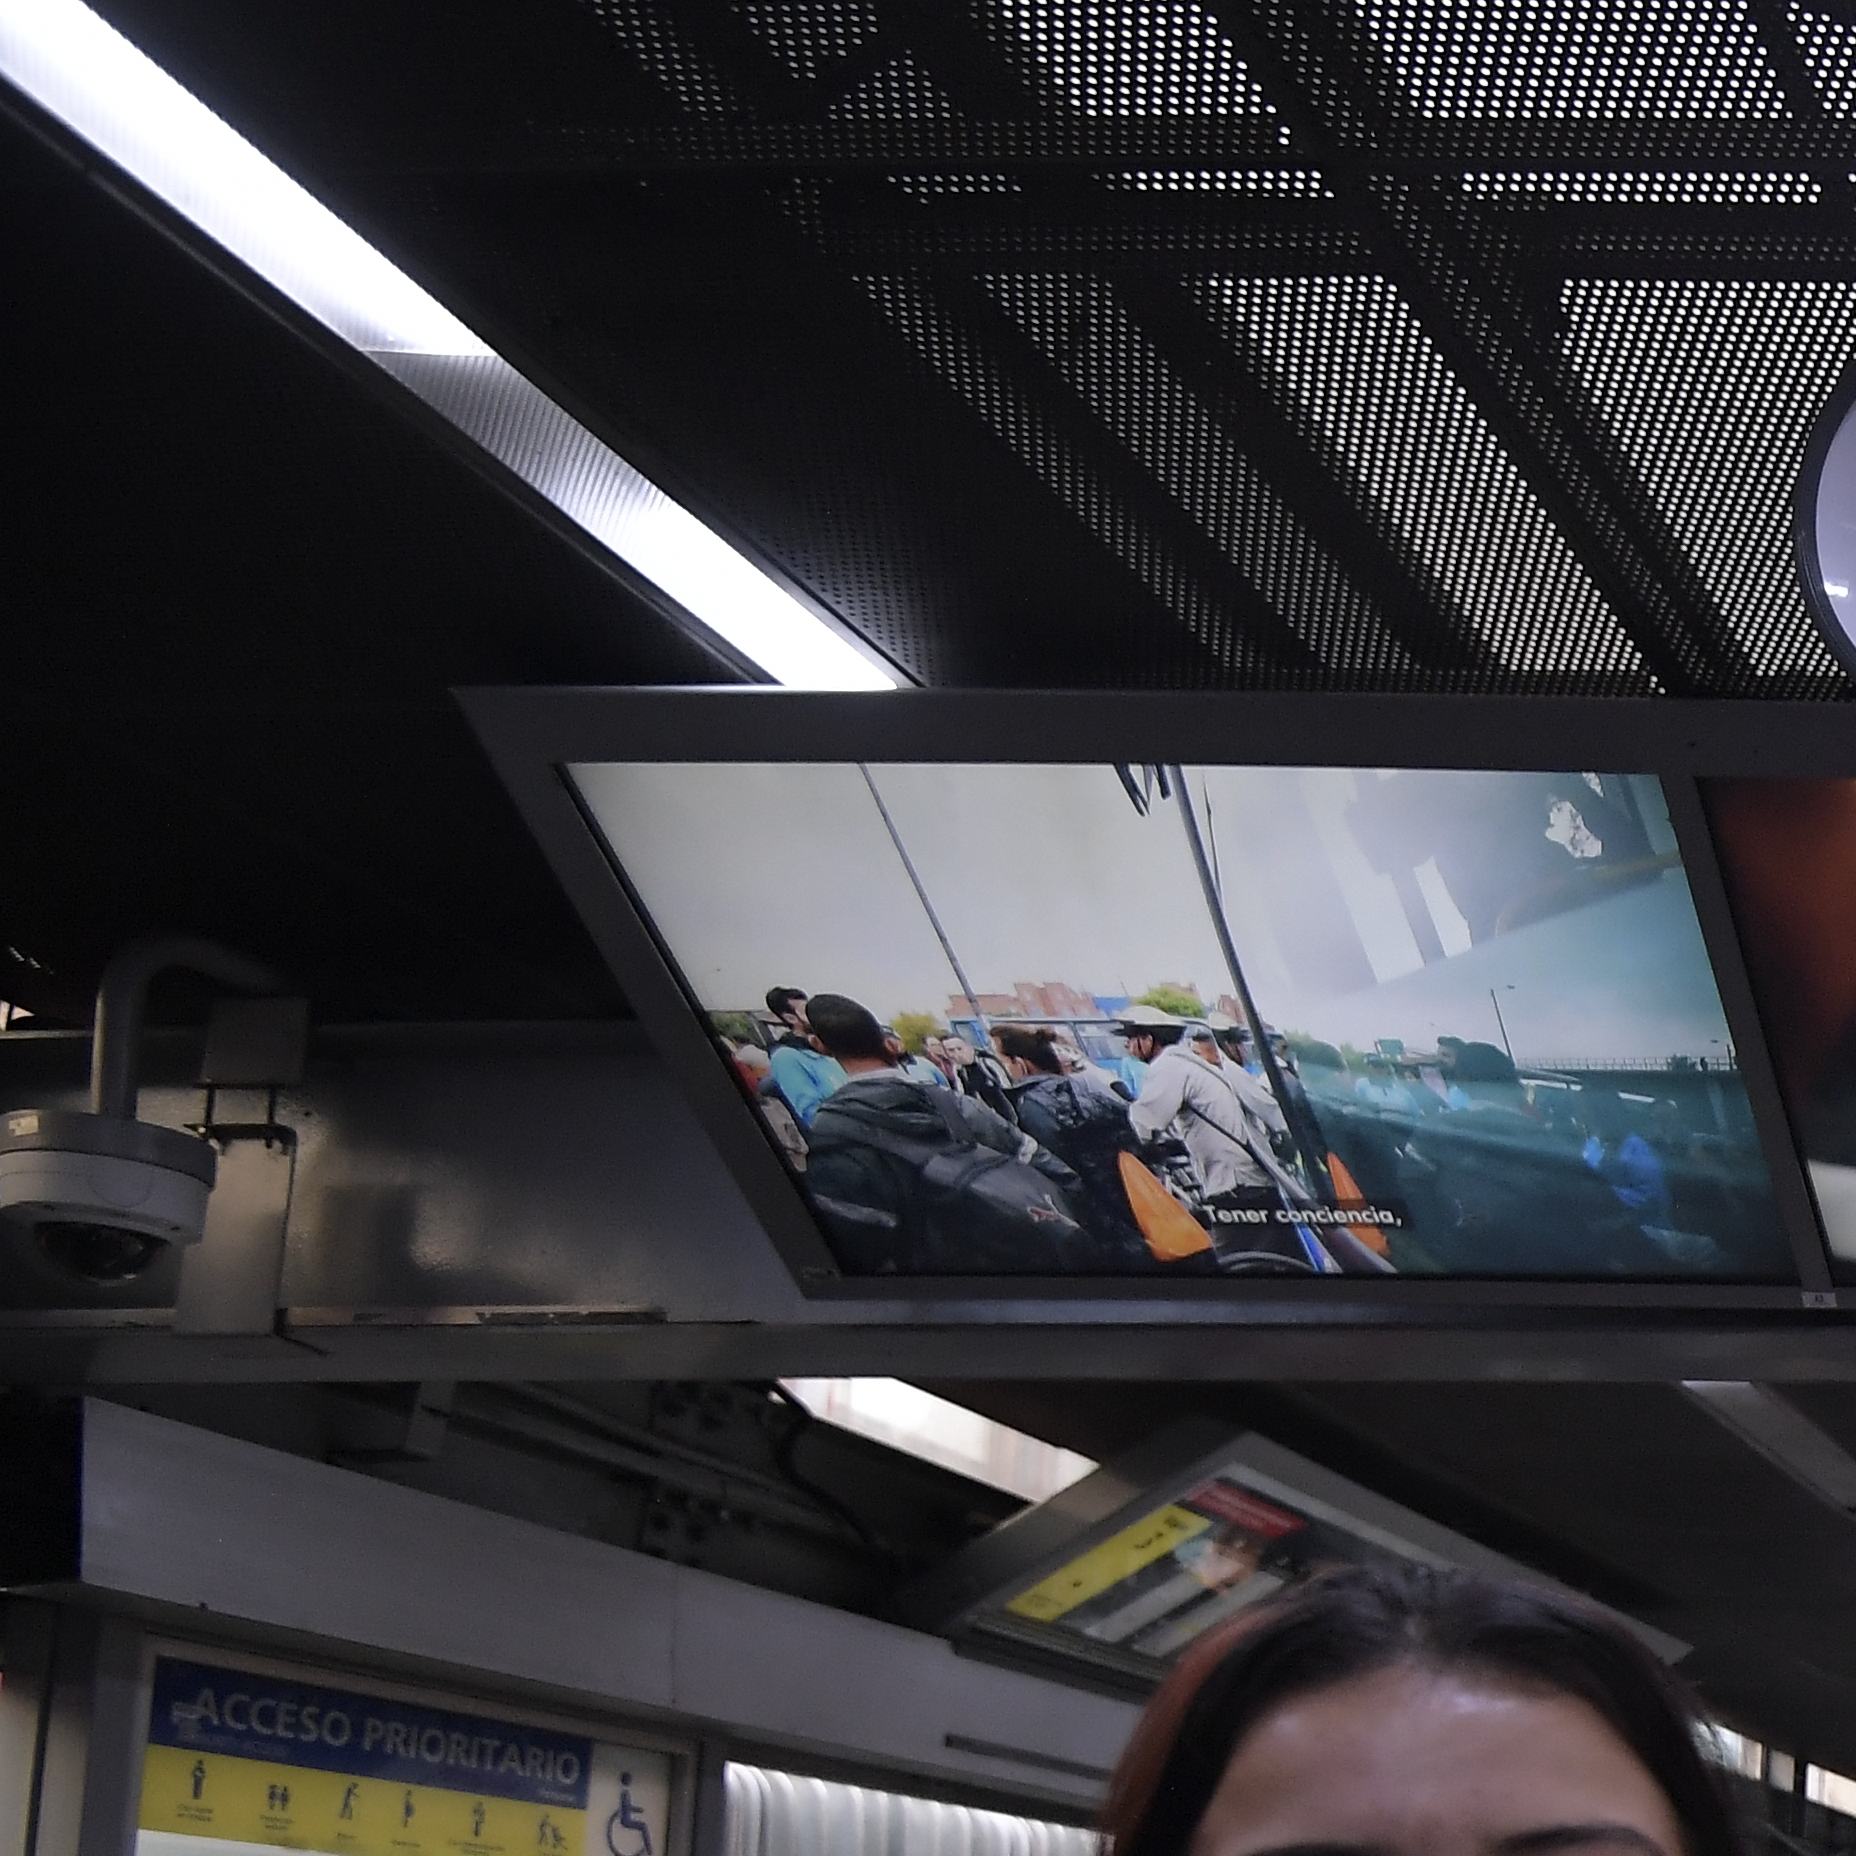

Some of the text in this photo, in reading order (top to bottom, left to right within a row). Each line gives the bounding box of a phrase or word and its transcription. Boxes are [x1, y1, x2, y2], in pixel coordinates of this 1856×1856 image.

[1202, 1204, 1402, 1227] Tener conciencia,
[197, 1687, 582, 1786] ACCESO PRIORITARIO
